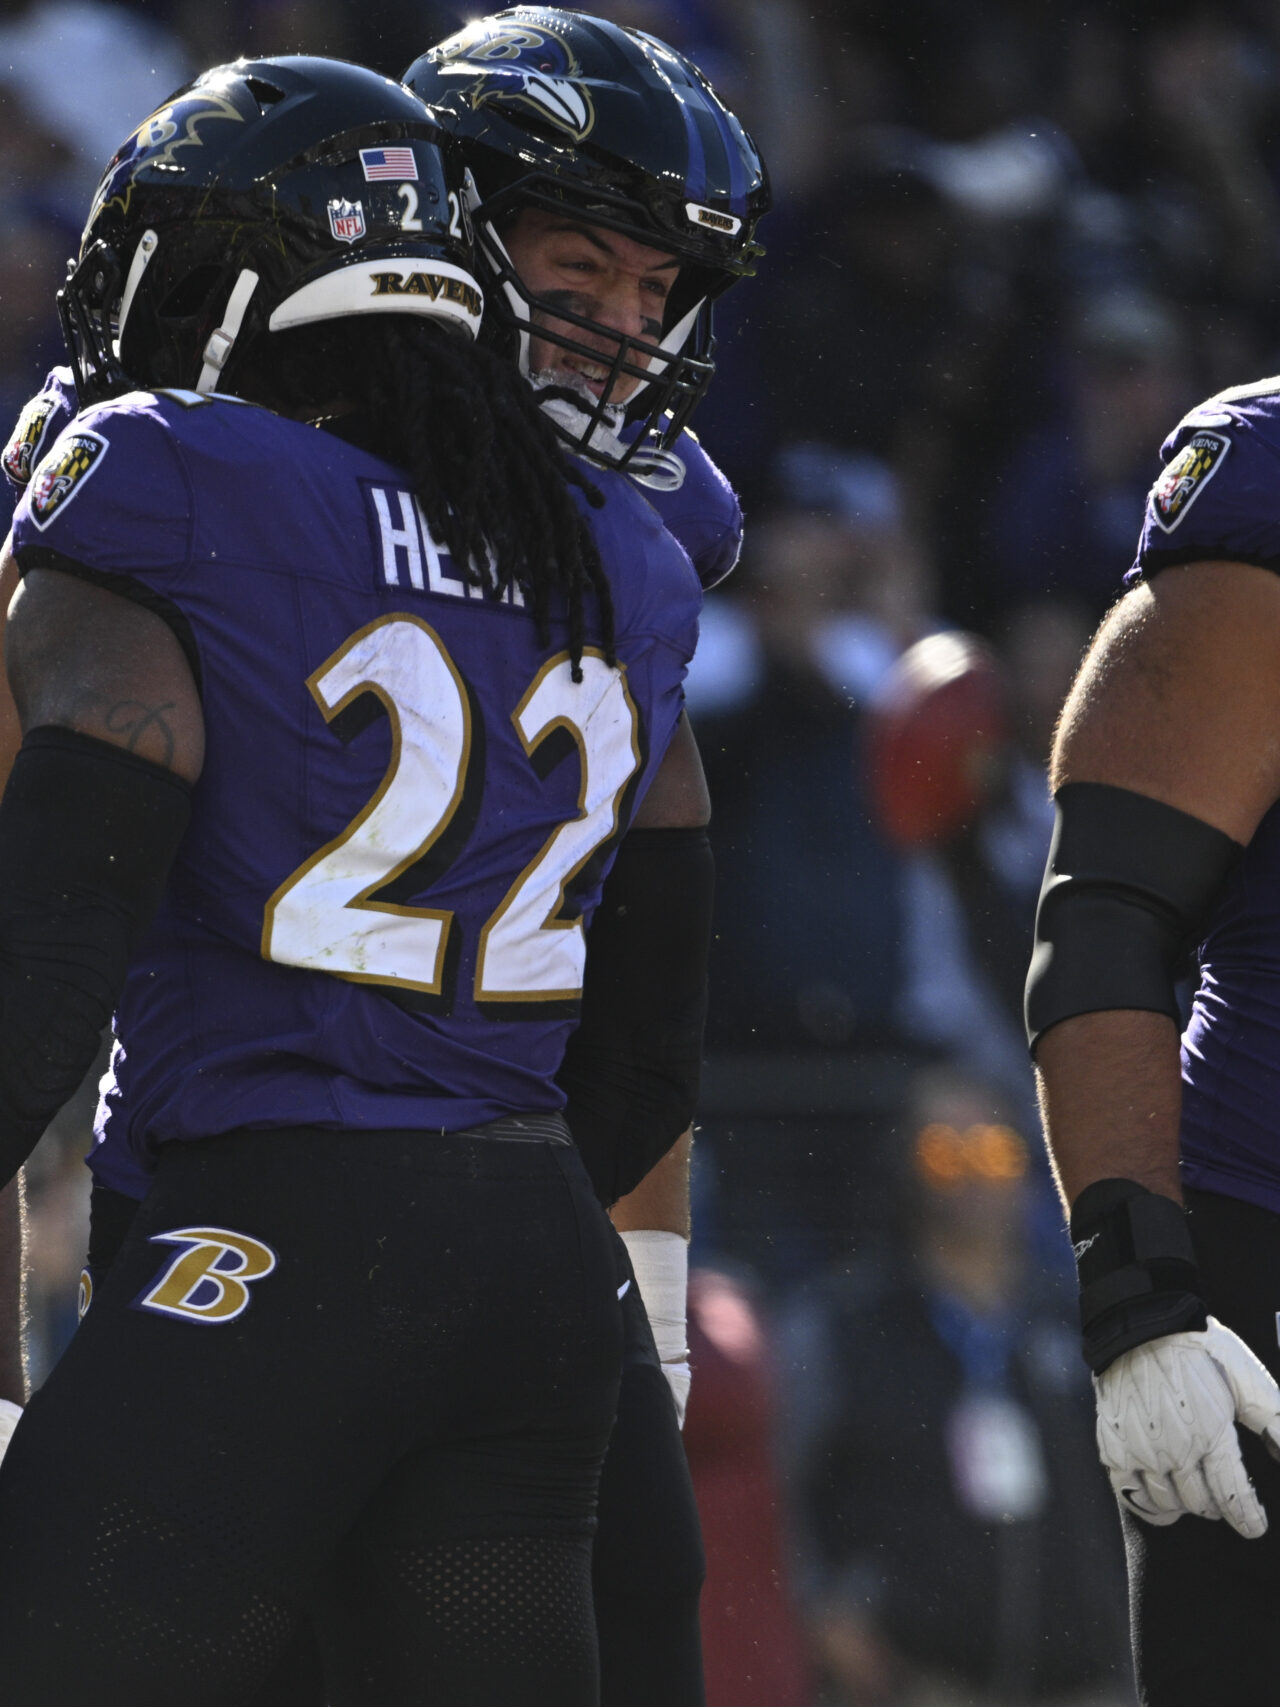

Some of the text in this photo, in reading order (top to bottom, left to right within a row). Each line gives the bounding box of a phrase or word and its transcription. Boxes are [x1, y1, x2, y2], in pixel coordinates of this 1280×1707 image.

[467, 28, 544, 60] B
[335, 216, 362, 238] NFL
[698, 209, 734, 231] RAVENS
[369, 272, 483, 317] RAVENS
[261, 611, 641, 1002] 22
[139, 1226, 277, 1323] B
